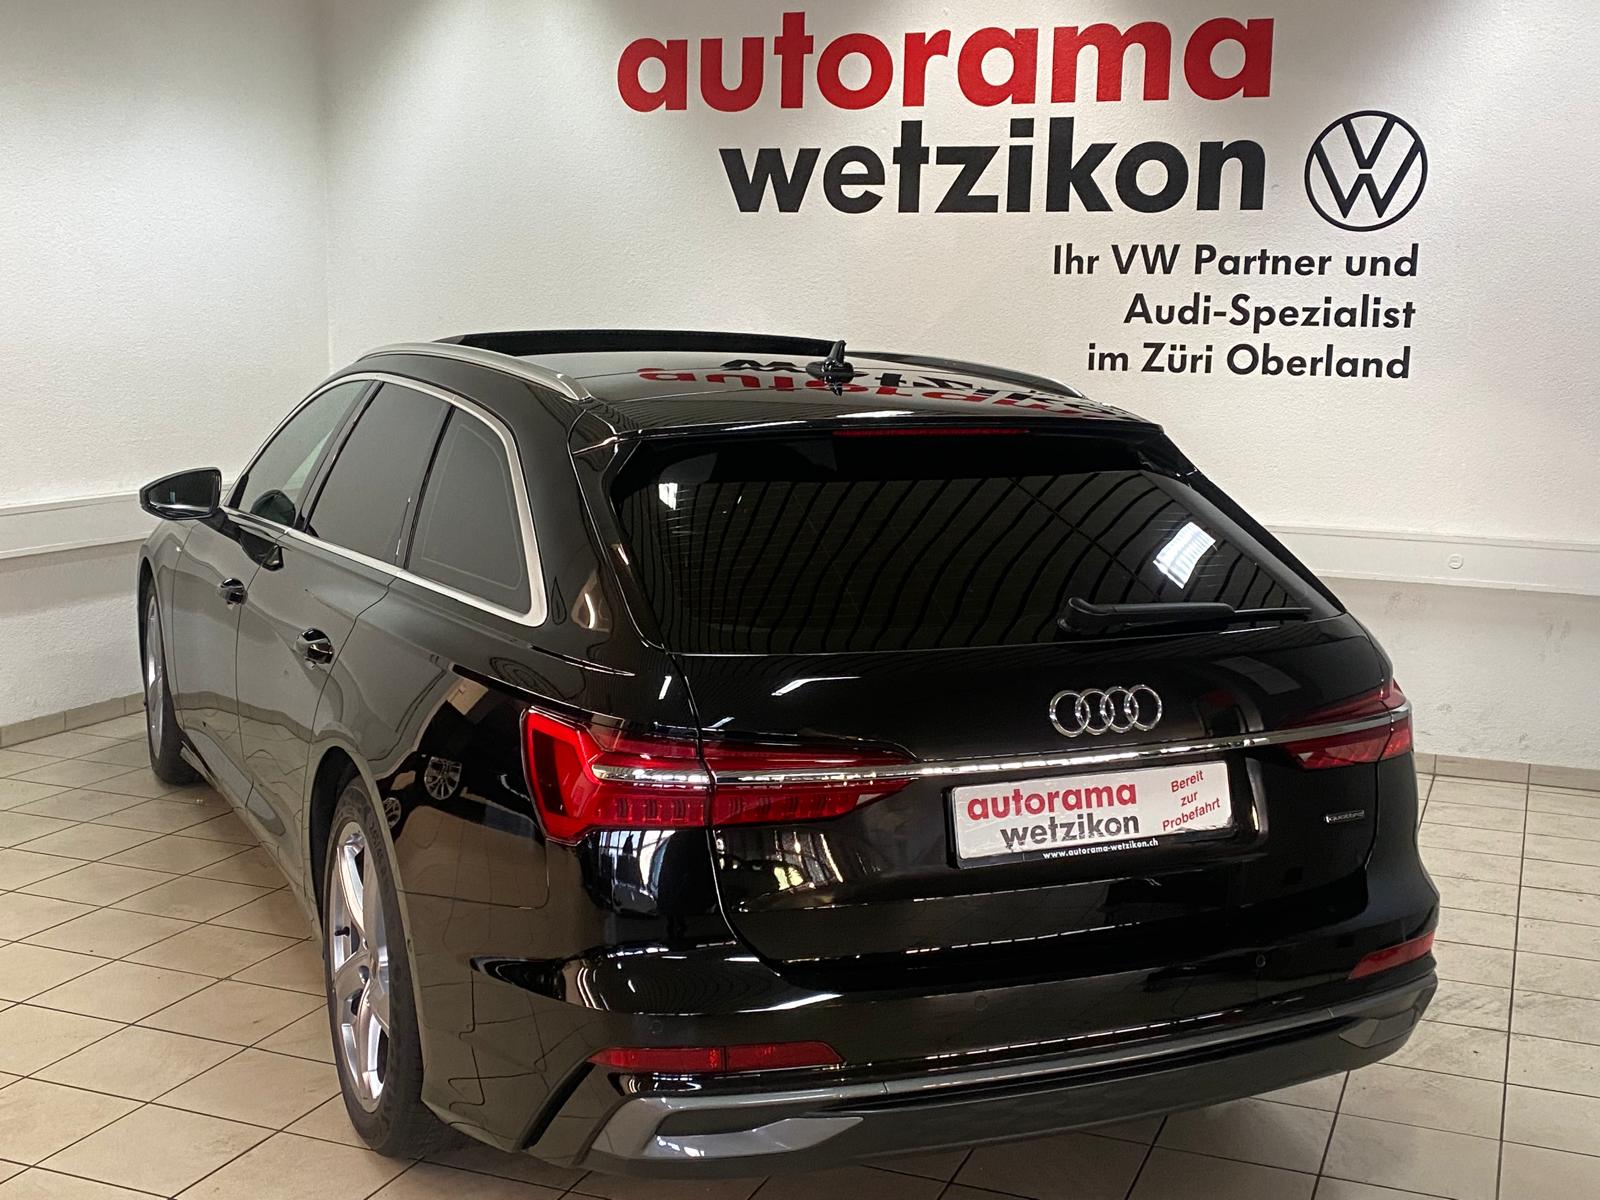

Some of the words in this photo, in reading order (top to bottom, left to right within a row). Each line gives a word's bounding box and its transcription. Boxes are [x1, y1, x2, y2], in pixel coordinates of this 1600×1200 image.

[618, 12, 1273, 112] autorama
[719, 117, 1265, 213] wetzikon
[1053, 243, 1099, 275] Ihr
[1112, 244, 1181, 275] VW
[1195, 244, 1332, 276] Partner
[1345, 243, 1419, 277] und
[1124, 292, 1416, 334] Audi-Spezialist
[1088, 343, 1129, 372] im
[1141, 342, 1213, 374] Züri
[1226, 343, 1411, 379] Oberland
[1171, 770, 1203, 792] Bereit
[967, 783, 1137, 821] autorama
[1163, 798, 1221, 831] Probefahrt
[1181, 792, 1198, 806] zur
[1000, 813, 1140, 847] wetzikon
[1043, 838, 1159, 860] www.autorama-wetzikon.ch
